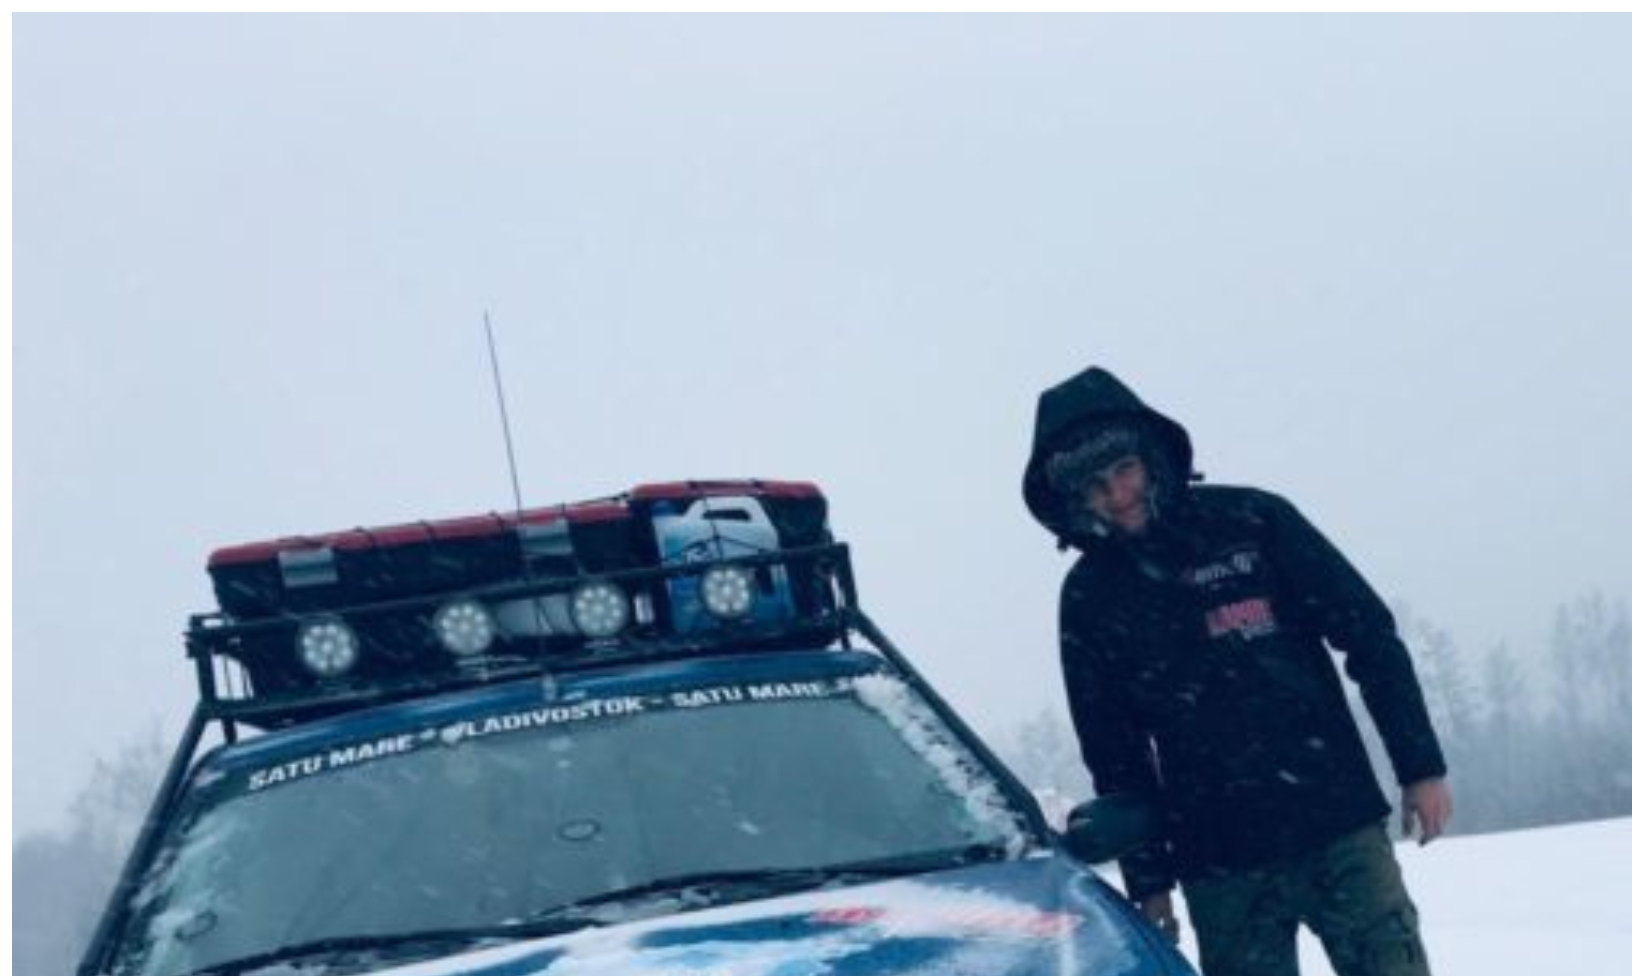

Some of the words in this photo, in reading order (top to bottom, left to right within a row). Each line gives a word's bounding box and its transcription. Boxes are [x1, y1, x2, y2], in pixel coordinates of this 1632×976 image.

[249, 757, 321, 790] SATU
[330, 734, 414, 767] MARE
[672, 686, 743, 708] SATU
